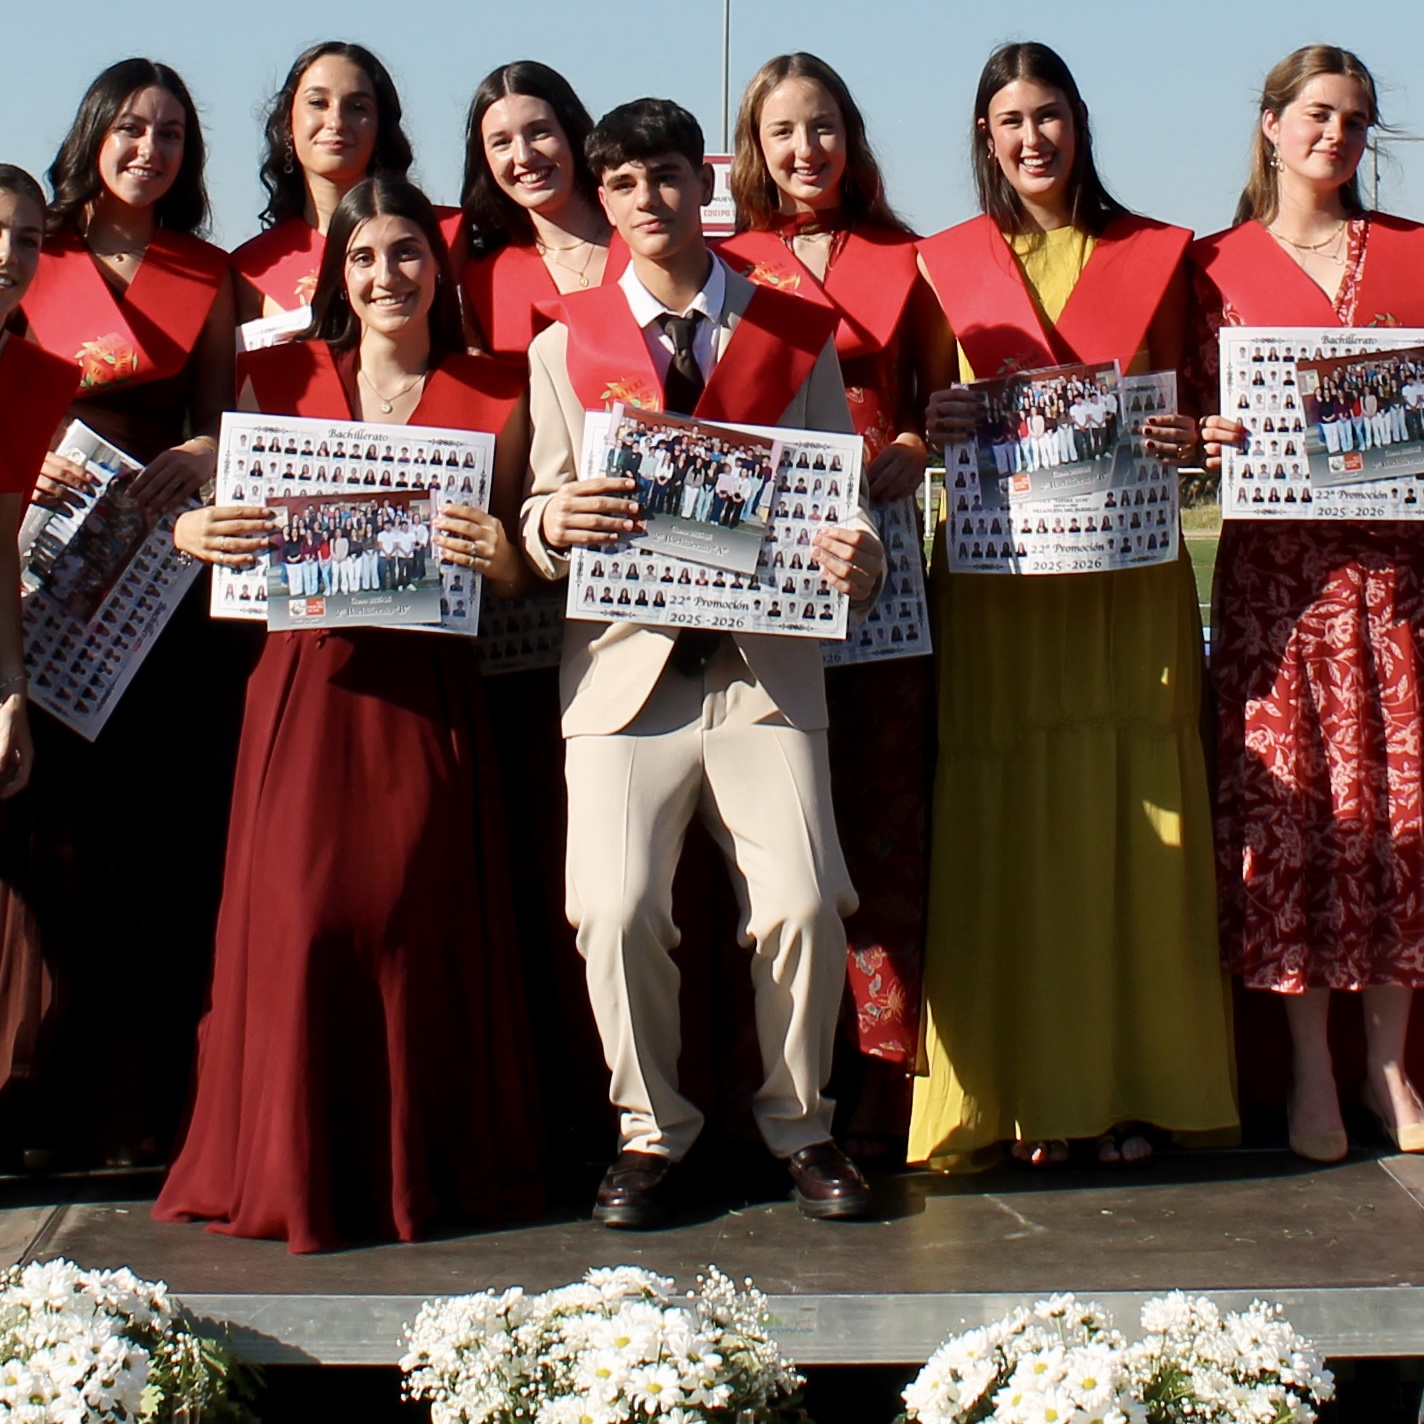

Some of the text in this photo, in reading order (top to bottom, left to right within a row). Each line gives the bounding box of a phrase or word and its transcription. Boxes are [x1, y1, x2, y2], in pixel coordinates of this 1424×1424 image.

[328, 427, 389, 441] Bachillerato
[1337, 489, 1388, 500] Promoción
[1317, 507, 1346, 517] 2025
[1054, 541, 1105, 553] Promoción
[1033, 561, 1062, 571] 2025
[693, 596, 749, 611] Promoción
[670, 613, 701, 626] 2025
